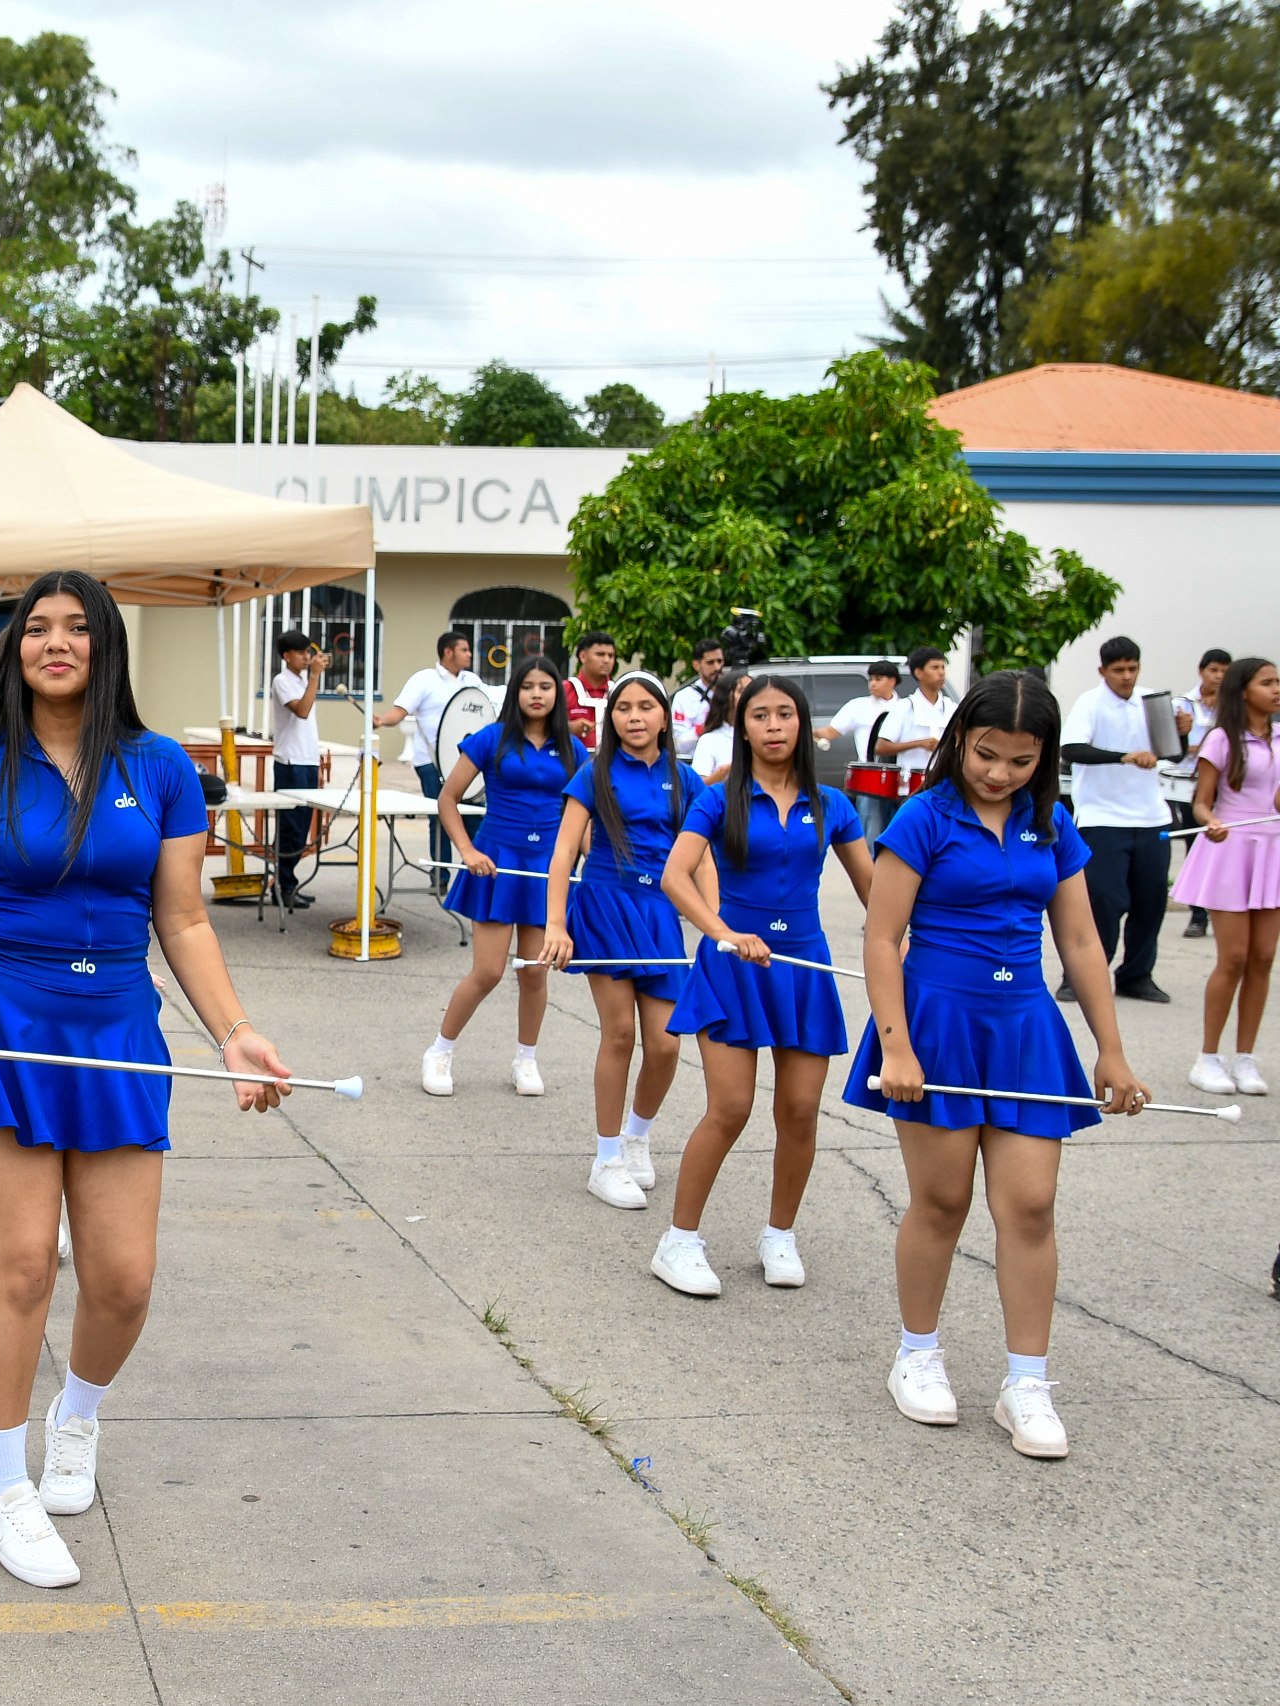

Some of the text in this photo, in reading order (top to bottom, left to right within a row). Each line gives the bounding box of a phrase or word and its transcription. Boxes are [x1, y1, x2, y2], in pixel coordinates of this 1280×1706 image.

[114, 792, 137, 809] alo
[1019, 829, 1038, 842] alo
[769, 918, 788, 932] alo
[71, 957, 96, 975] alo
[993, 966, 1014, 982] alo
